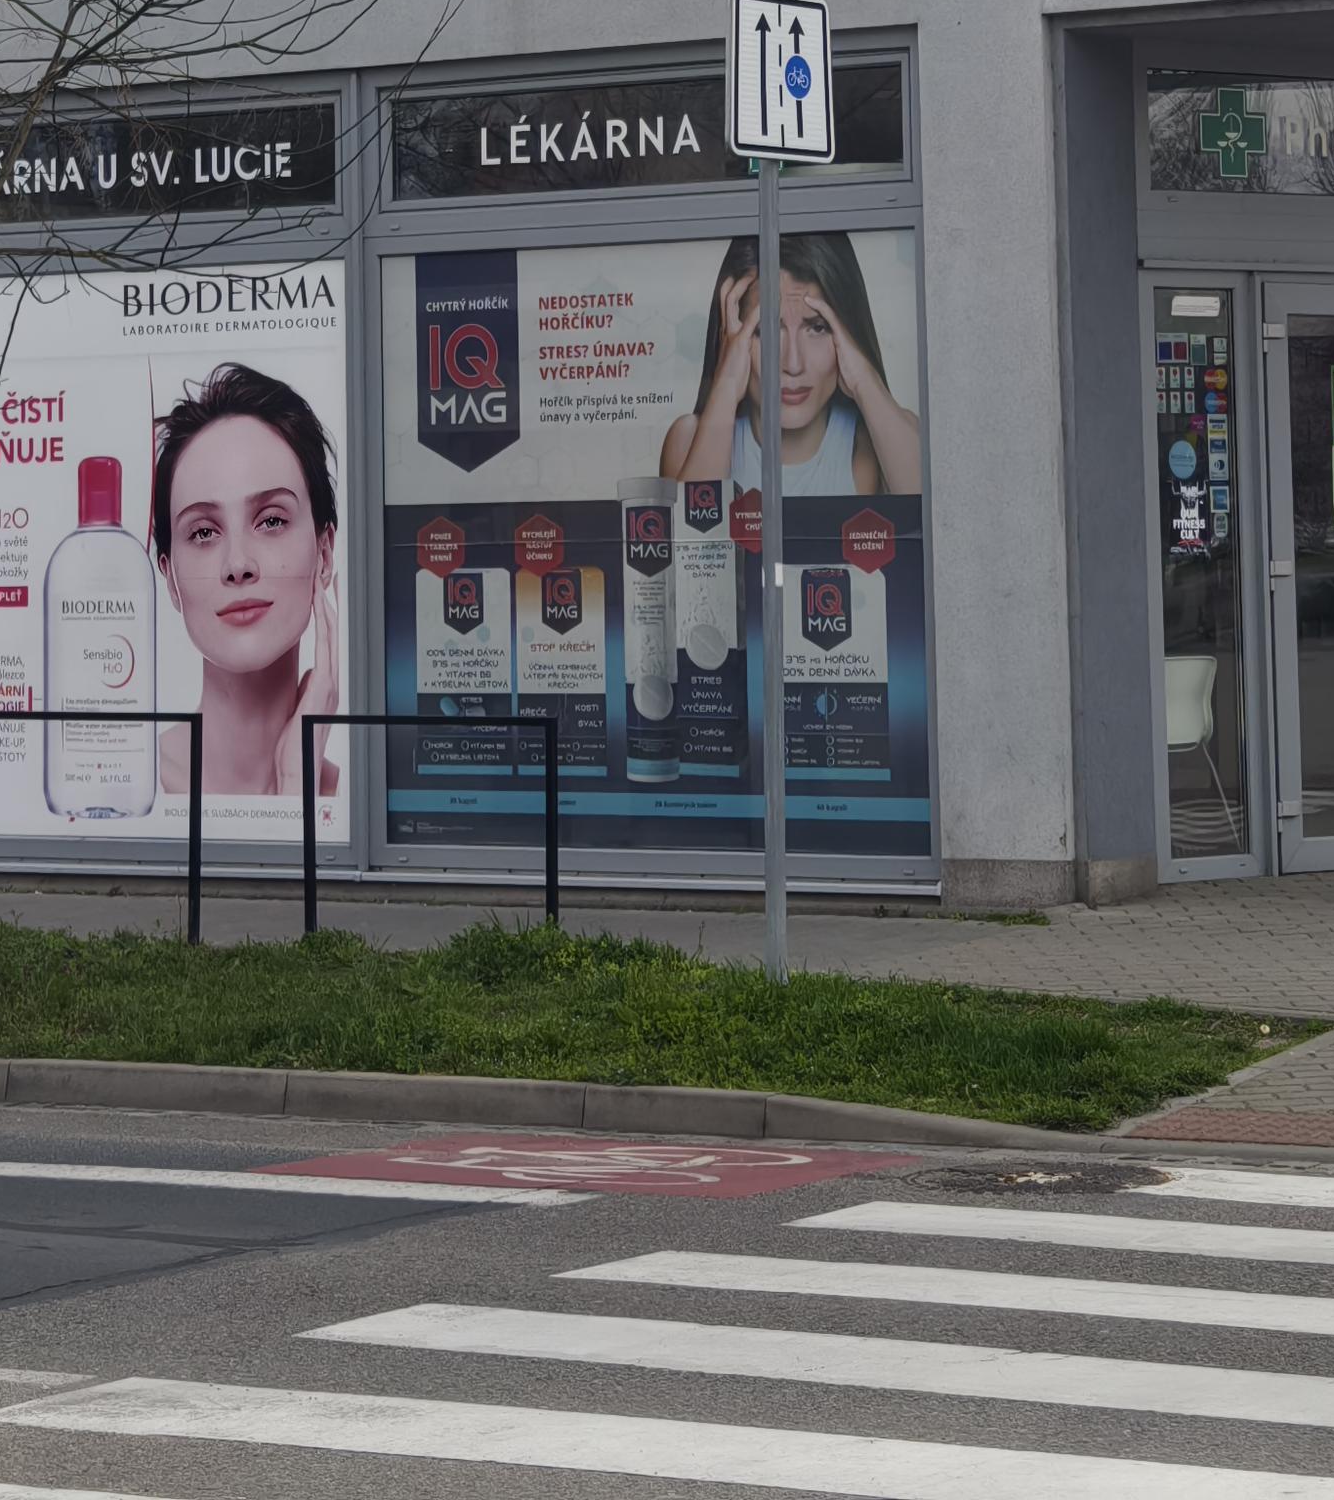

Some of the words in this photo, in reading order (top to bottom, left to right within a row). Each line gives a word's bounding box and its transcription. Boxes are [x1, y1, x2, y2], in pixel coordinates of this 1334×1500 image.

[481, 111, 701, 166] LÉKÁRNA
[98, 153, 118, 188] U
[130, 149, 181, 187] SV.
[195, 142, 292, 184] LUCIE
[123, 275, 336, 317] BIODERMA
[538, 292, 634, 311] NEDOSTATEK
[426, 298, 466, 312] CHYTRÝ
[468, 296, 508, 311] HOŘČÍK
[123, 323, 210, 336] LABORATOIRE
[216, 316, 337, 332] DERMATOLOGIQUE
[539, 311, 614, 331] HOŘČÍKU?
[429, 323, 505, 390] IQ
[539, 345, 589, 360] STRES?
[593, 340, 655, 358] ÚNAVA?
[539, 360, 630, 381] VYČERPÁNÍ?
[2, 390, 66, 425] ČISTÍ
[539, 395, 573, 408] Hořčík
[576, 394, 618, 409] přispívá
[620, 393, 634, 405] ke
[636, 391, 674, 404] snížení
[430, 391, 507, 426] MAG
[540, 412, 571, 424] únavy
[582, 408, 638, 424] vyčerpání.
[688, 484, 716, 509] IQ
[689, 508, 718, 520] MAG
[629, 510, 665, 541] IQ
[1173, 519, 1206, 530] FITNESS
[4, 536, 28, 546] světě
[1180, 529, 1200, 540] CULT
[630, 543, 669, 559] MAG
[0, 589, 22, 601] PLEŤ
[447, 578, 477, 606] IQ
[547, 578, 576, 606] IQ
[61, 600, 136, 614] BIODERMA
[808, 584, 844, 616] IQ
[449, 605, 479, 619] MAG
[547, 605, 578, 619] MAG
[808, 617, 846, 632] MAG
[477, 646, 505, 657] DÁVKA
[530, 643, 556, 652] STOP
[559, 640, 596, 652] KŘEČÍM
[83, 649, 123, 660] Sensibio
[785, 655, 806, 664] 375
[825, 653, 870, 664] HOŘČÍKU
[463, 658, 499, 668] HOŘČÍKU
[783, 668, 804, 677] 00%
[809, 666, 841, 677] DENNÍ
[844, 665, 876, 677] DÁVKA
[691, 676, 722, 684] STRES
[692, 688, 722, 699] ÚNAVA
[574, 704, 599, 712] KOSTI
[681, 703, 733, 713] VYČERPÁNÍ
[578, 720, 604, 728] SVALY
[164, 809, 188, 817] BIOLO
[251, 809, 303, 819] DERMATOLOG
